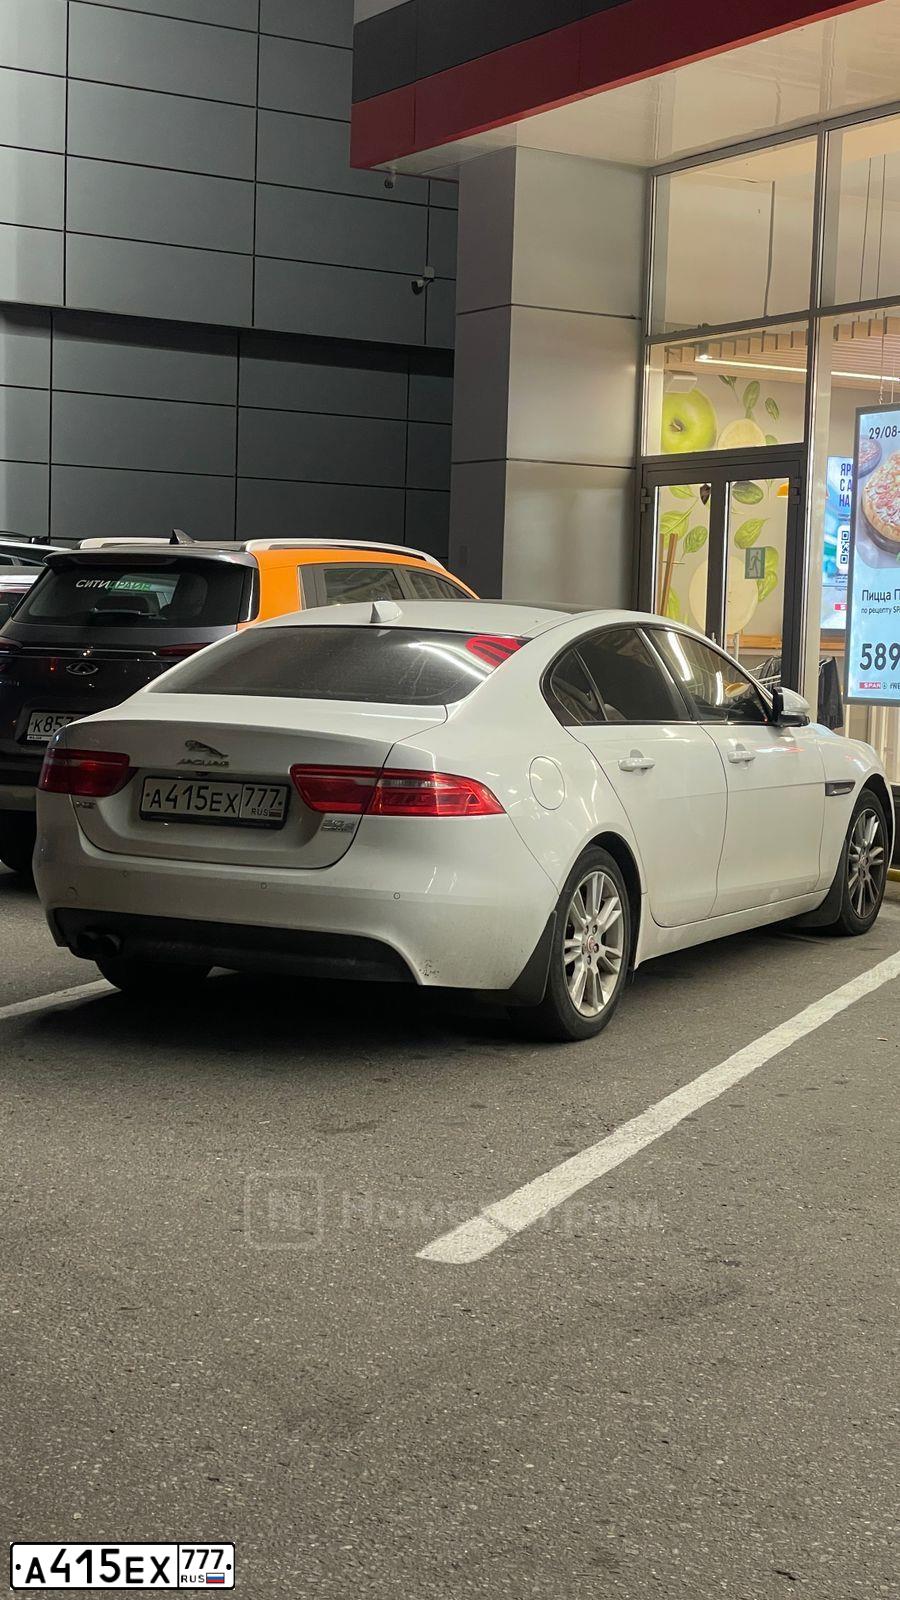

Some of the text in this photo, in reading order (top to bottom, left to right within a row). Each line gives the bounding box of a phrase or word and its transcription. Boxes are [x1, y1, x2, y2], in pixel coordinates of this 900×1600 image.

[862, 590, 891, 603] Пицца
[860, 643, 900, 670] 589
[149, 783, 280, 813] А415ЕХ 777
[251, 807, 269, 816] RUS
